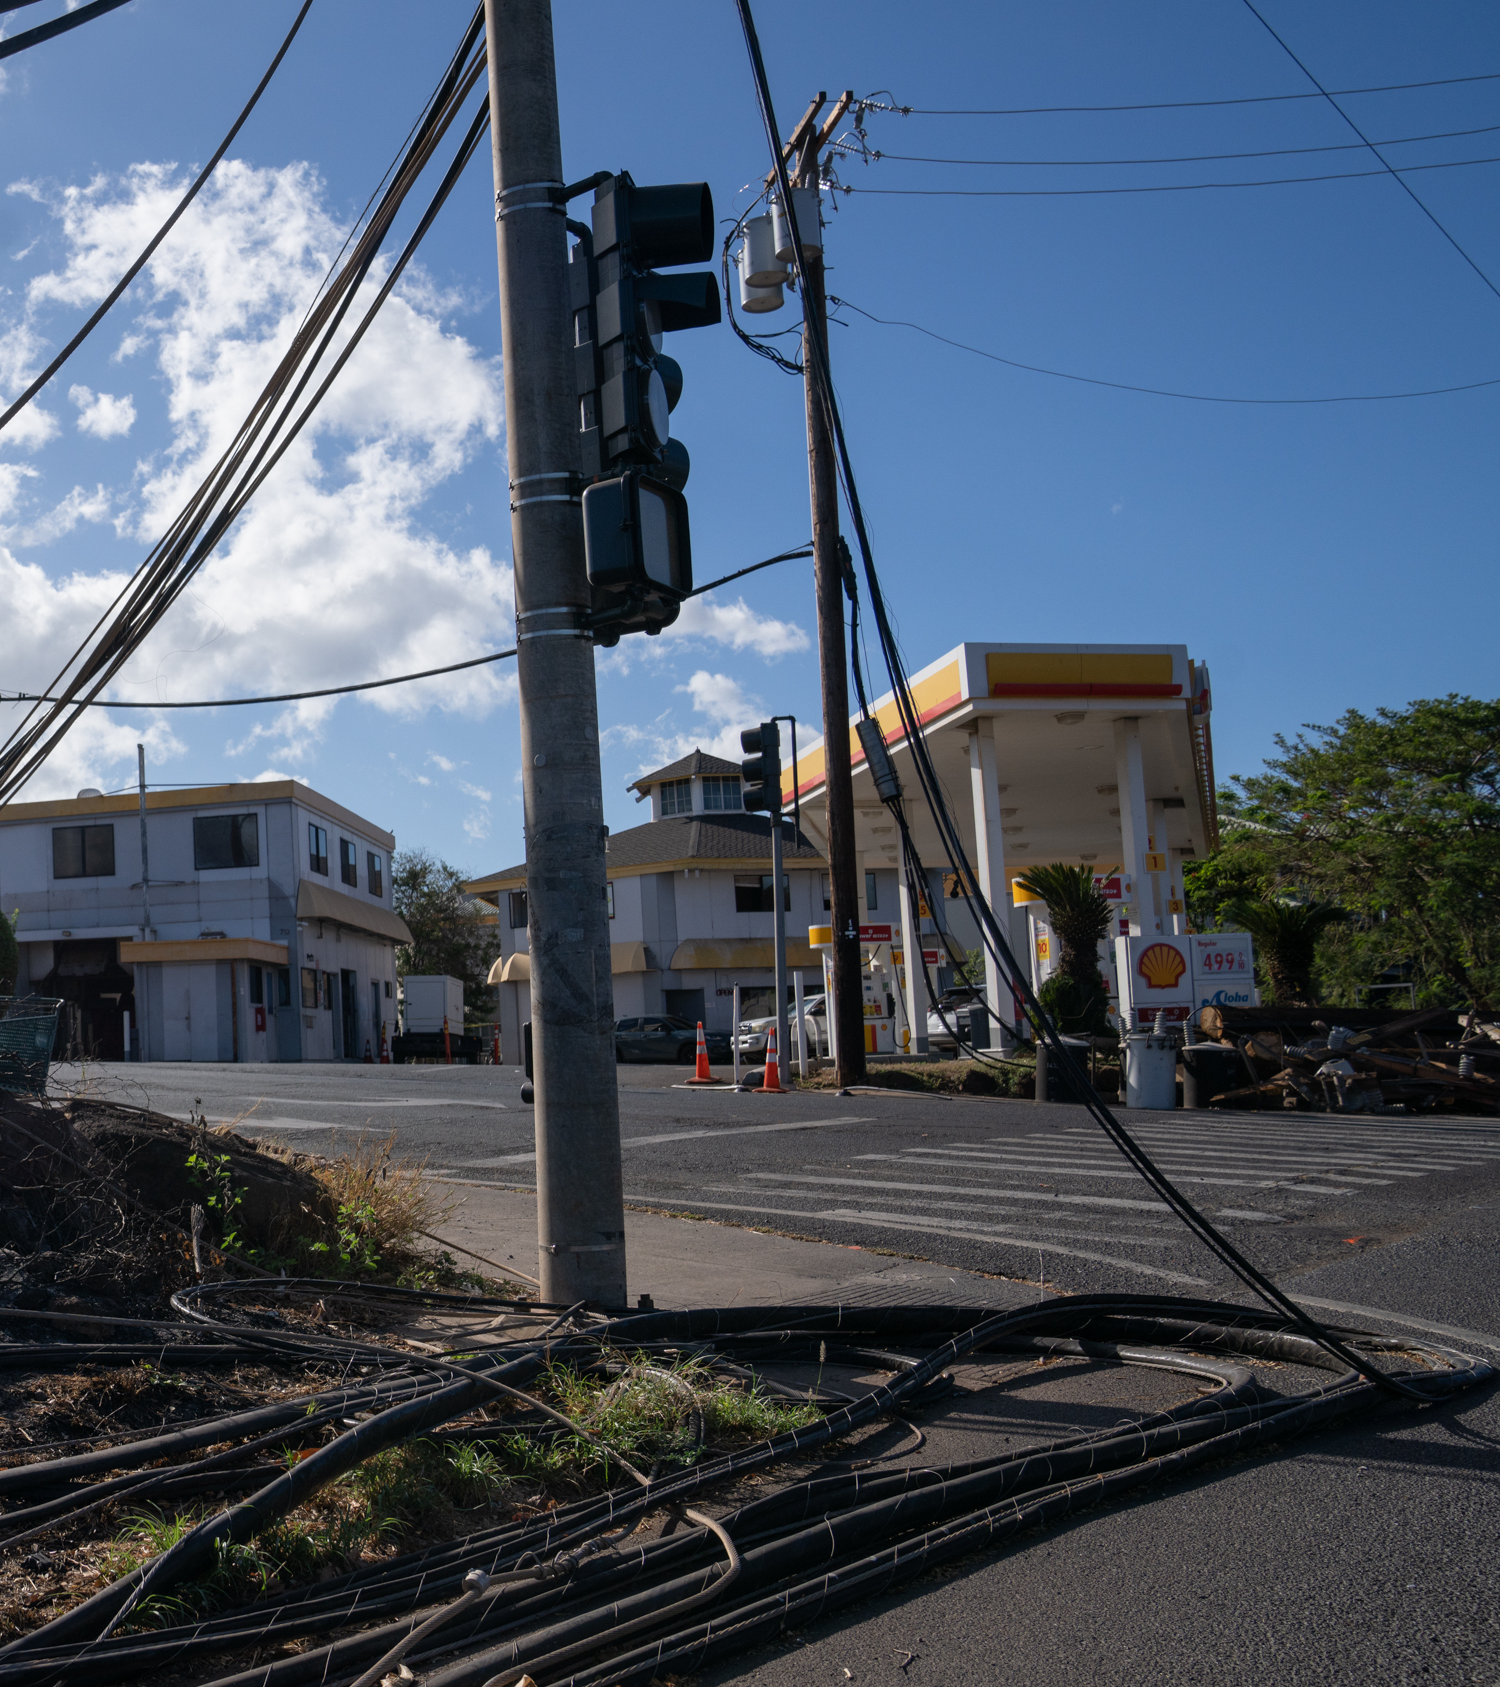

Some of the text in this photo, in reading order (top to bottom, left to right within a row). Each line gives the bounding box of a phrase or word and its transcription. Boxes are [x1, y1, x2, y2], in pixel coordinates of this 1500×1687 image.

[1152, 856, 1158, 868] 1
[920, 905, 926, 915] 5
[1173, 901, 1179, 911] 3
[1198, 940, 1217, 948] Regular
[1204, 952, 1234, 970] 499
[716, 988, 734, 996] OPEN
